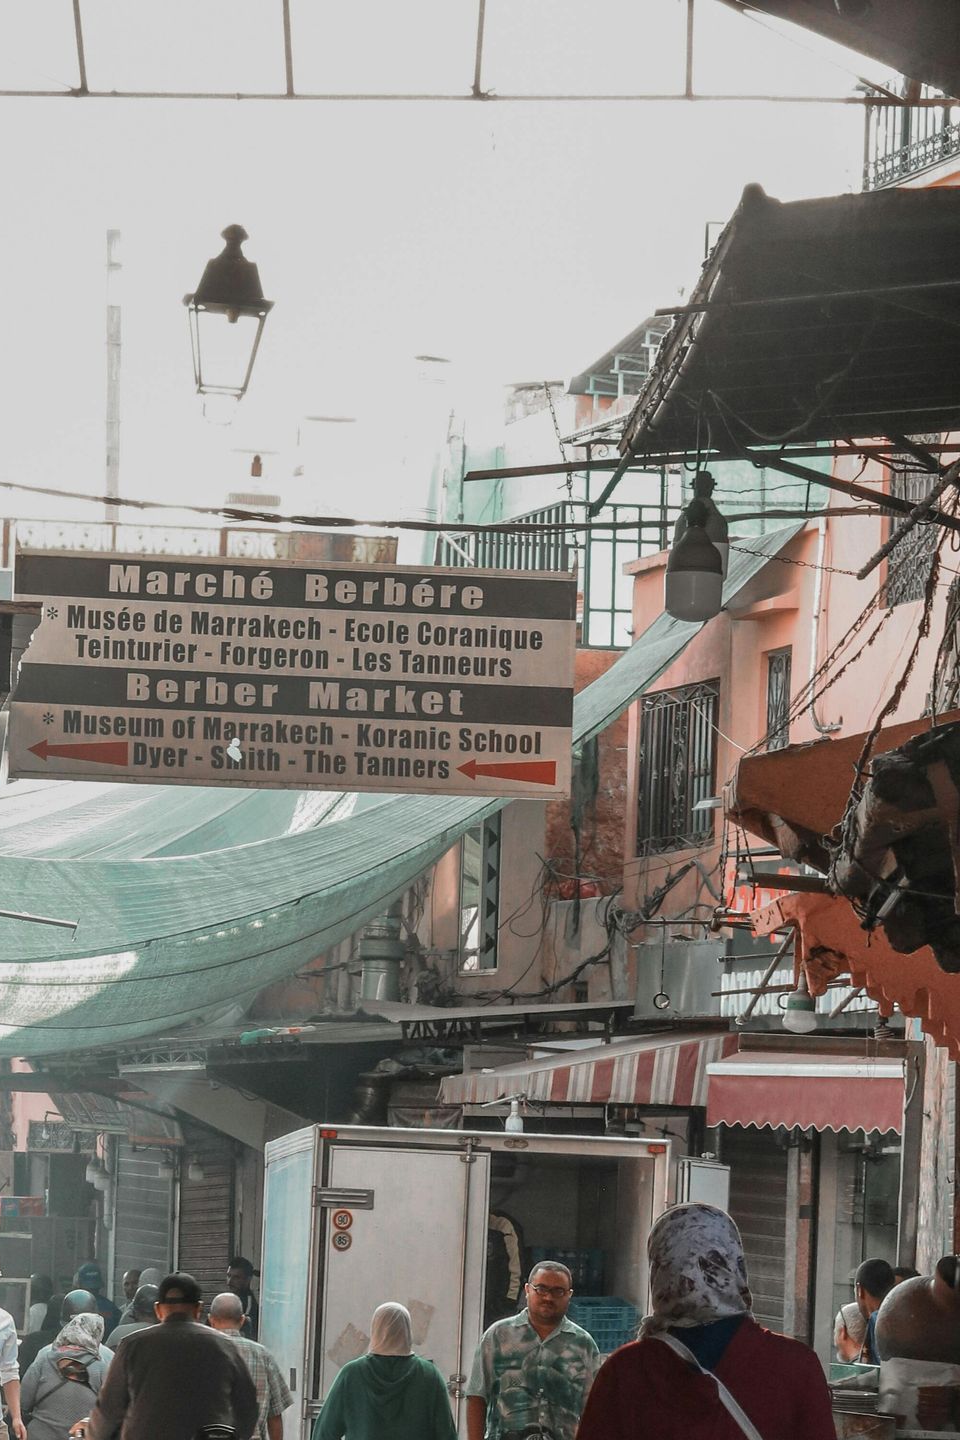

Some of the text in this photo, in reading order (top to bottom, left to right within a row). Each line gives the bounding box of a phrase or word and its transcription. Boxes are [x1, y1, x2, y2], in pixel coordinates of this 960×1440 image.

[108, 563, 484, 610] Marché Berbére
[66, 605, 146, 632] Musée
[153, 610, 183, 635] de
[191, 611, 321, 640] Marrakech
[344, 618, 410, 645] Ecole
[417, 621, 543, 651] Coranique
[75, 634, 198, 664] Teinturier
[220, 642, 329, 670] Forgeron
[352, 647, 392, 673] Les
[399, 649, 513, 678] Tanneurs
[126, 673, 464, 716] Berber Market
[62, 710, 164, 738] Museum
[172, 716, 196, 739] of
[203, 717, 334, 745] Marrakech
[357, 723, 451, 751] Koranic
[458, 727, 542, 754] School
[133, 742, 188, 768] Dyer
[304, 750, 347, 775] The
[354, 752, 450, 779] Tanners
[336, 1235, 347, 1246] 85
[337, 1214, 349, 1226] 90
